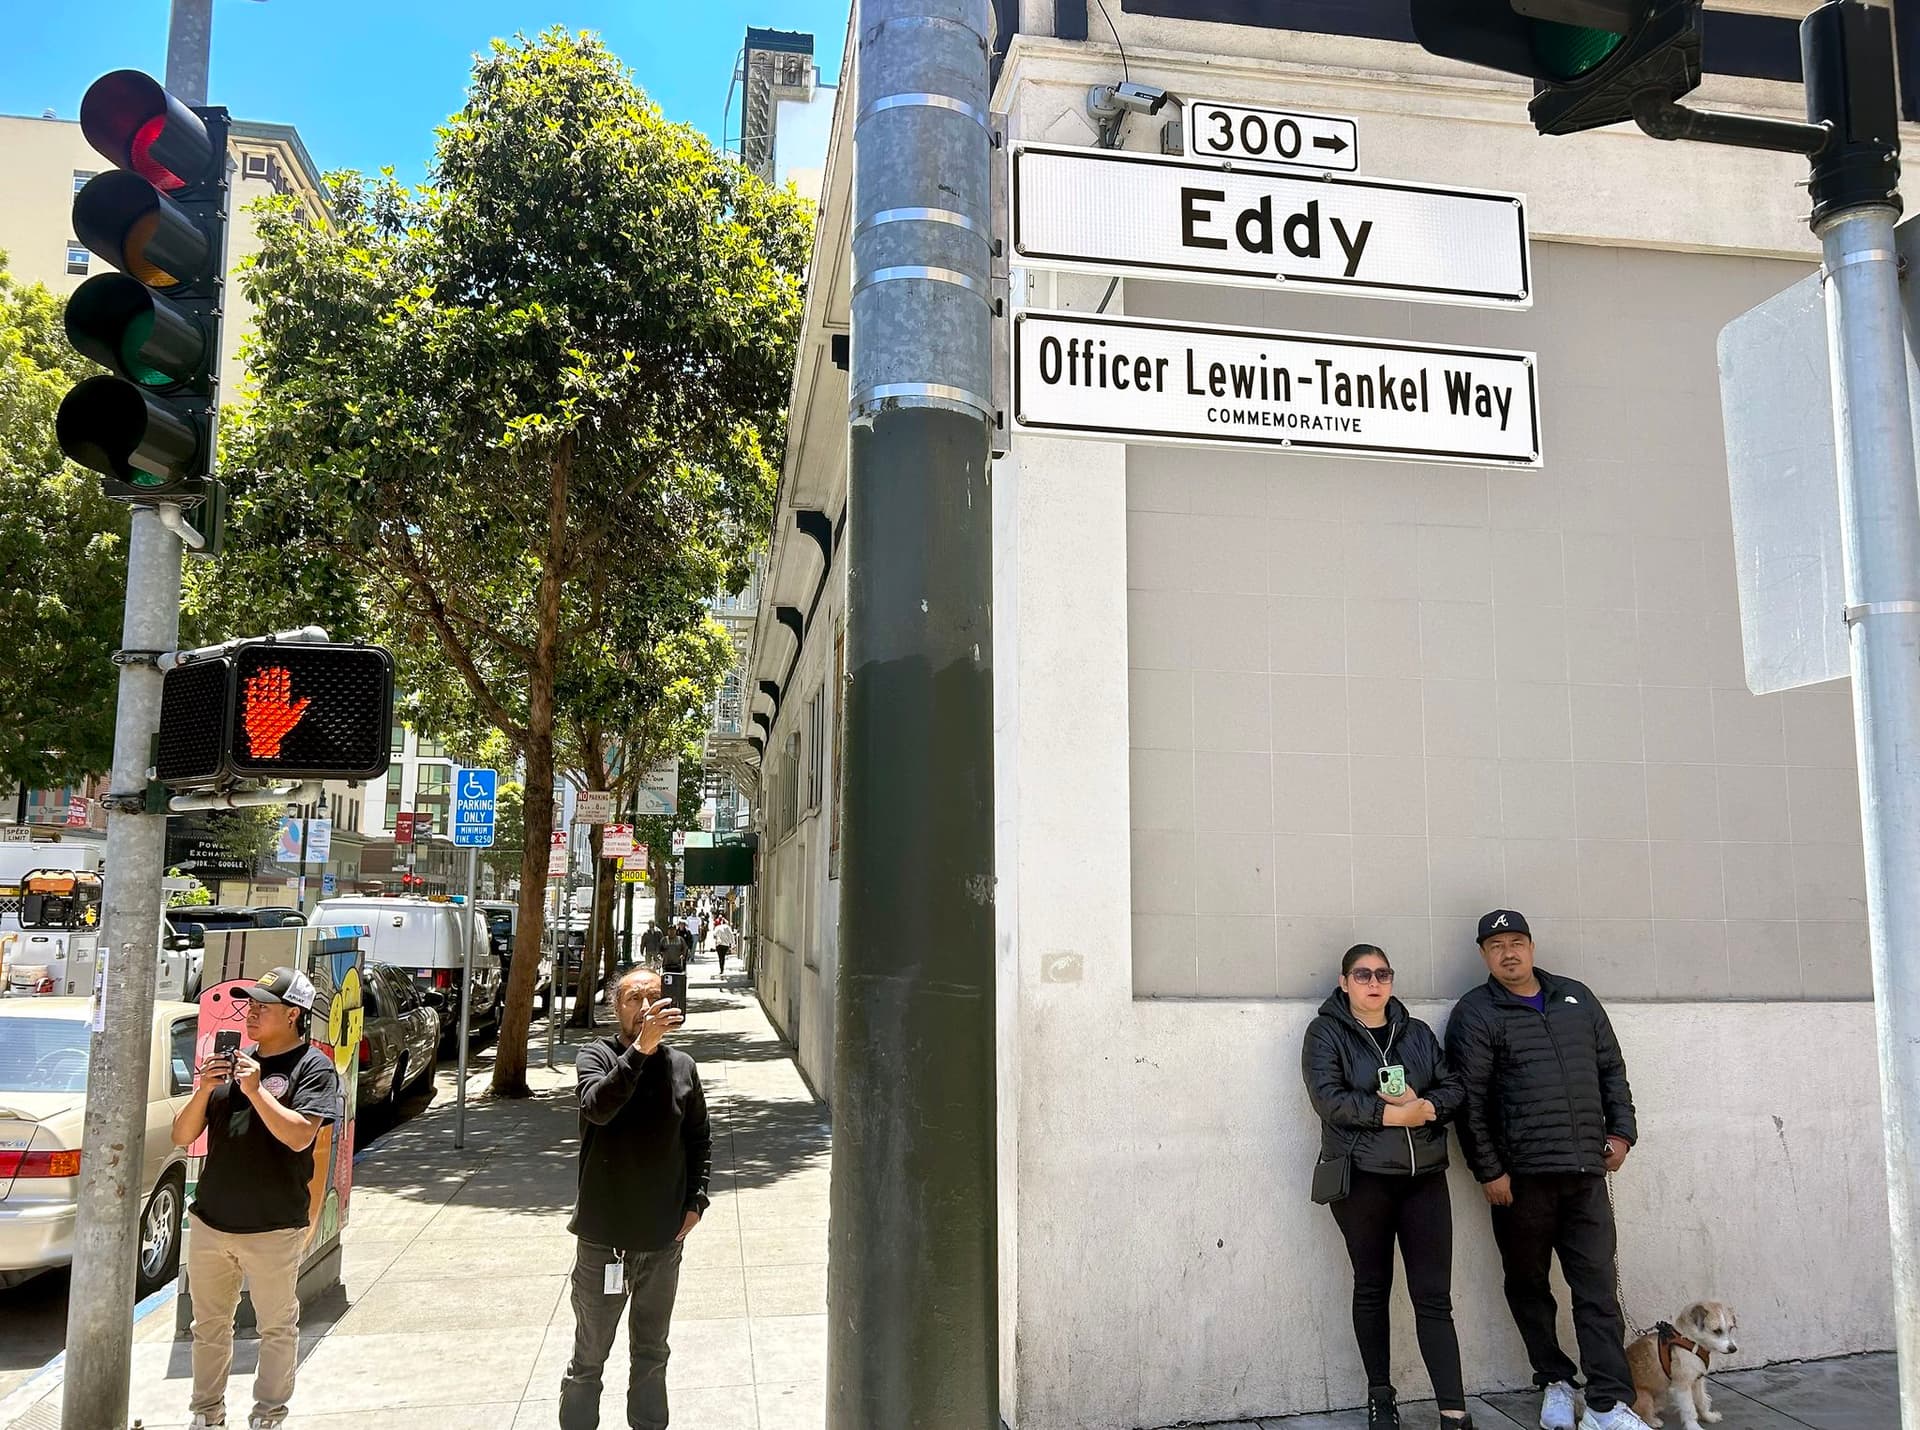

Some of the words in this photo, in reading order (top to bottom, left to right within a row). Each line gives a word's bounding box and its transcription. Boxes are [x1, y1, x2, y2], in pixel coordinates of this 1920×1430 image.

[1207, 110, 1302, 159] 300
[1180, 186, 1373, 278] Eddy
[1039, 335, 1169, 394] Officer
[1186, 348, 1430, 413] Lewin-Tankel
[1444, 369, 1513, 432] Way
[1207, 407, 1363, 433] COMMEMORATIVE
[588, 793, 609, 801] PARKING
[457, 799, 493, 811] PARKING
[463, 811, 486, 823] ONLY
[460, 826, 488, 835] MINIMUM
[456, 835, 470, 844] FINE
[615, 871, 645, 880] SCHOOL
